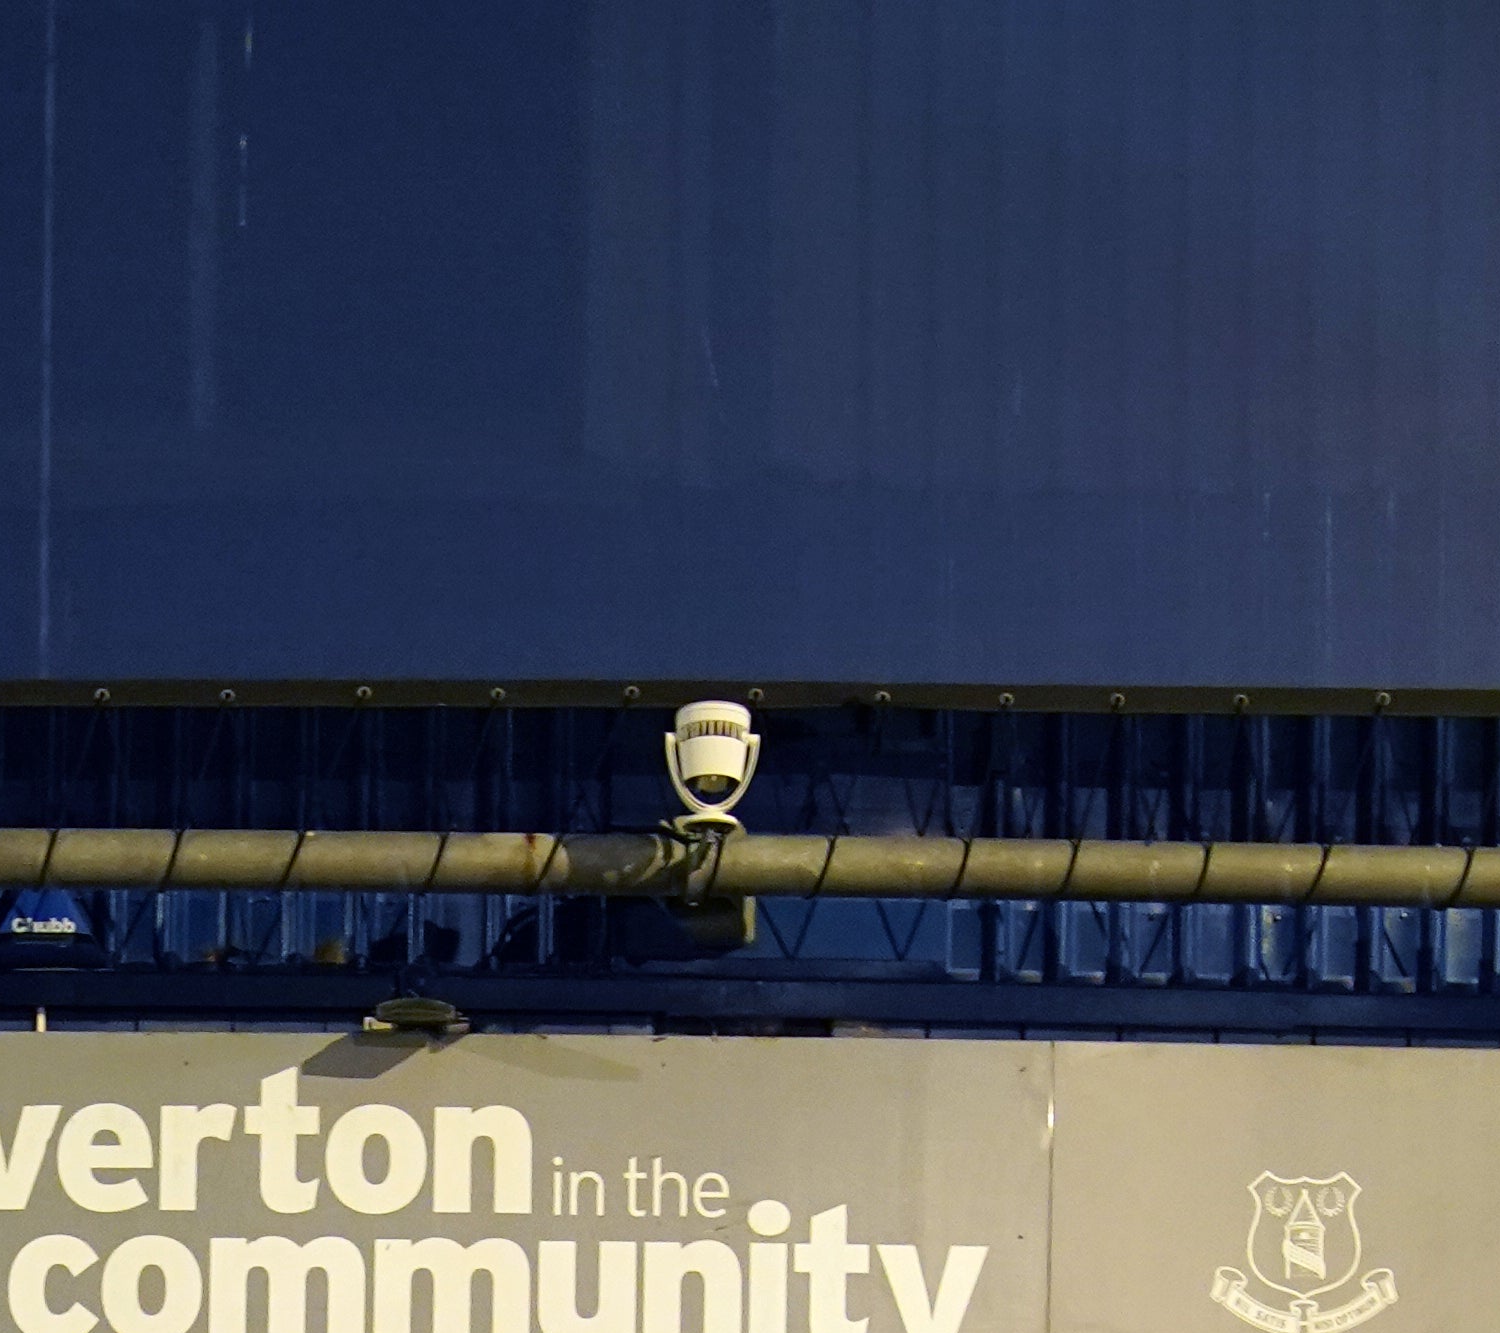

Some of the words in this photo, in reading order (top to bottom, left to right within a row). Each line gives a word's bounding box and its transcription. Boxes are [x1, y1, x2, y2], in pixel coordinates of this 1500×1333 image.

[11, 917, 76, 934] Chubb
[553, 1156, 604, 1218] in
[623, 1158, 730, 1218] the
